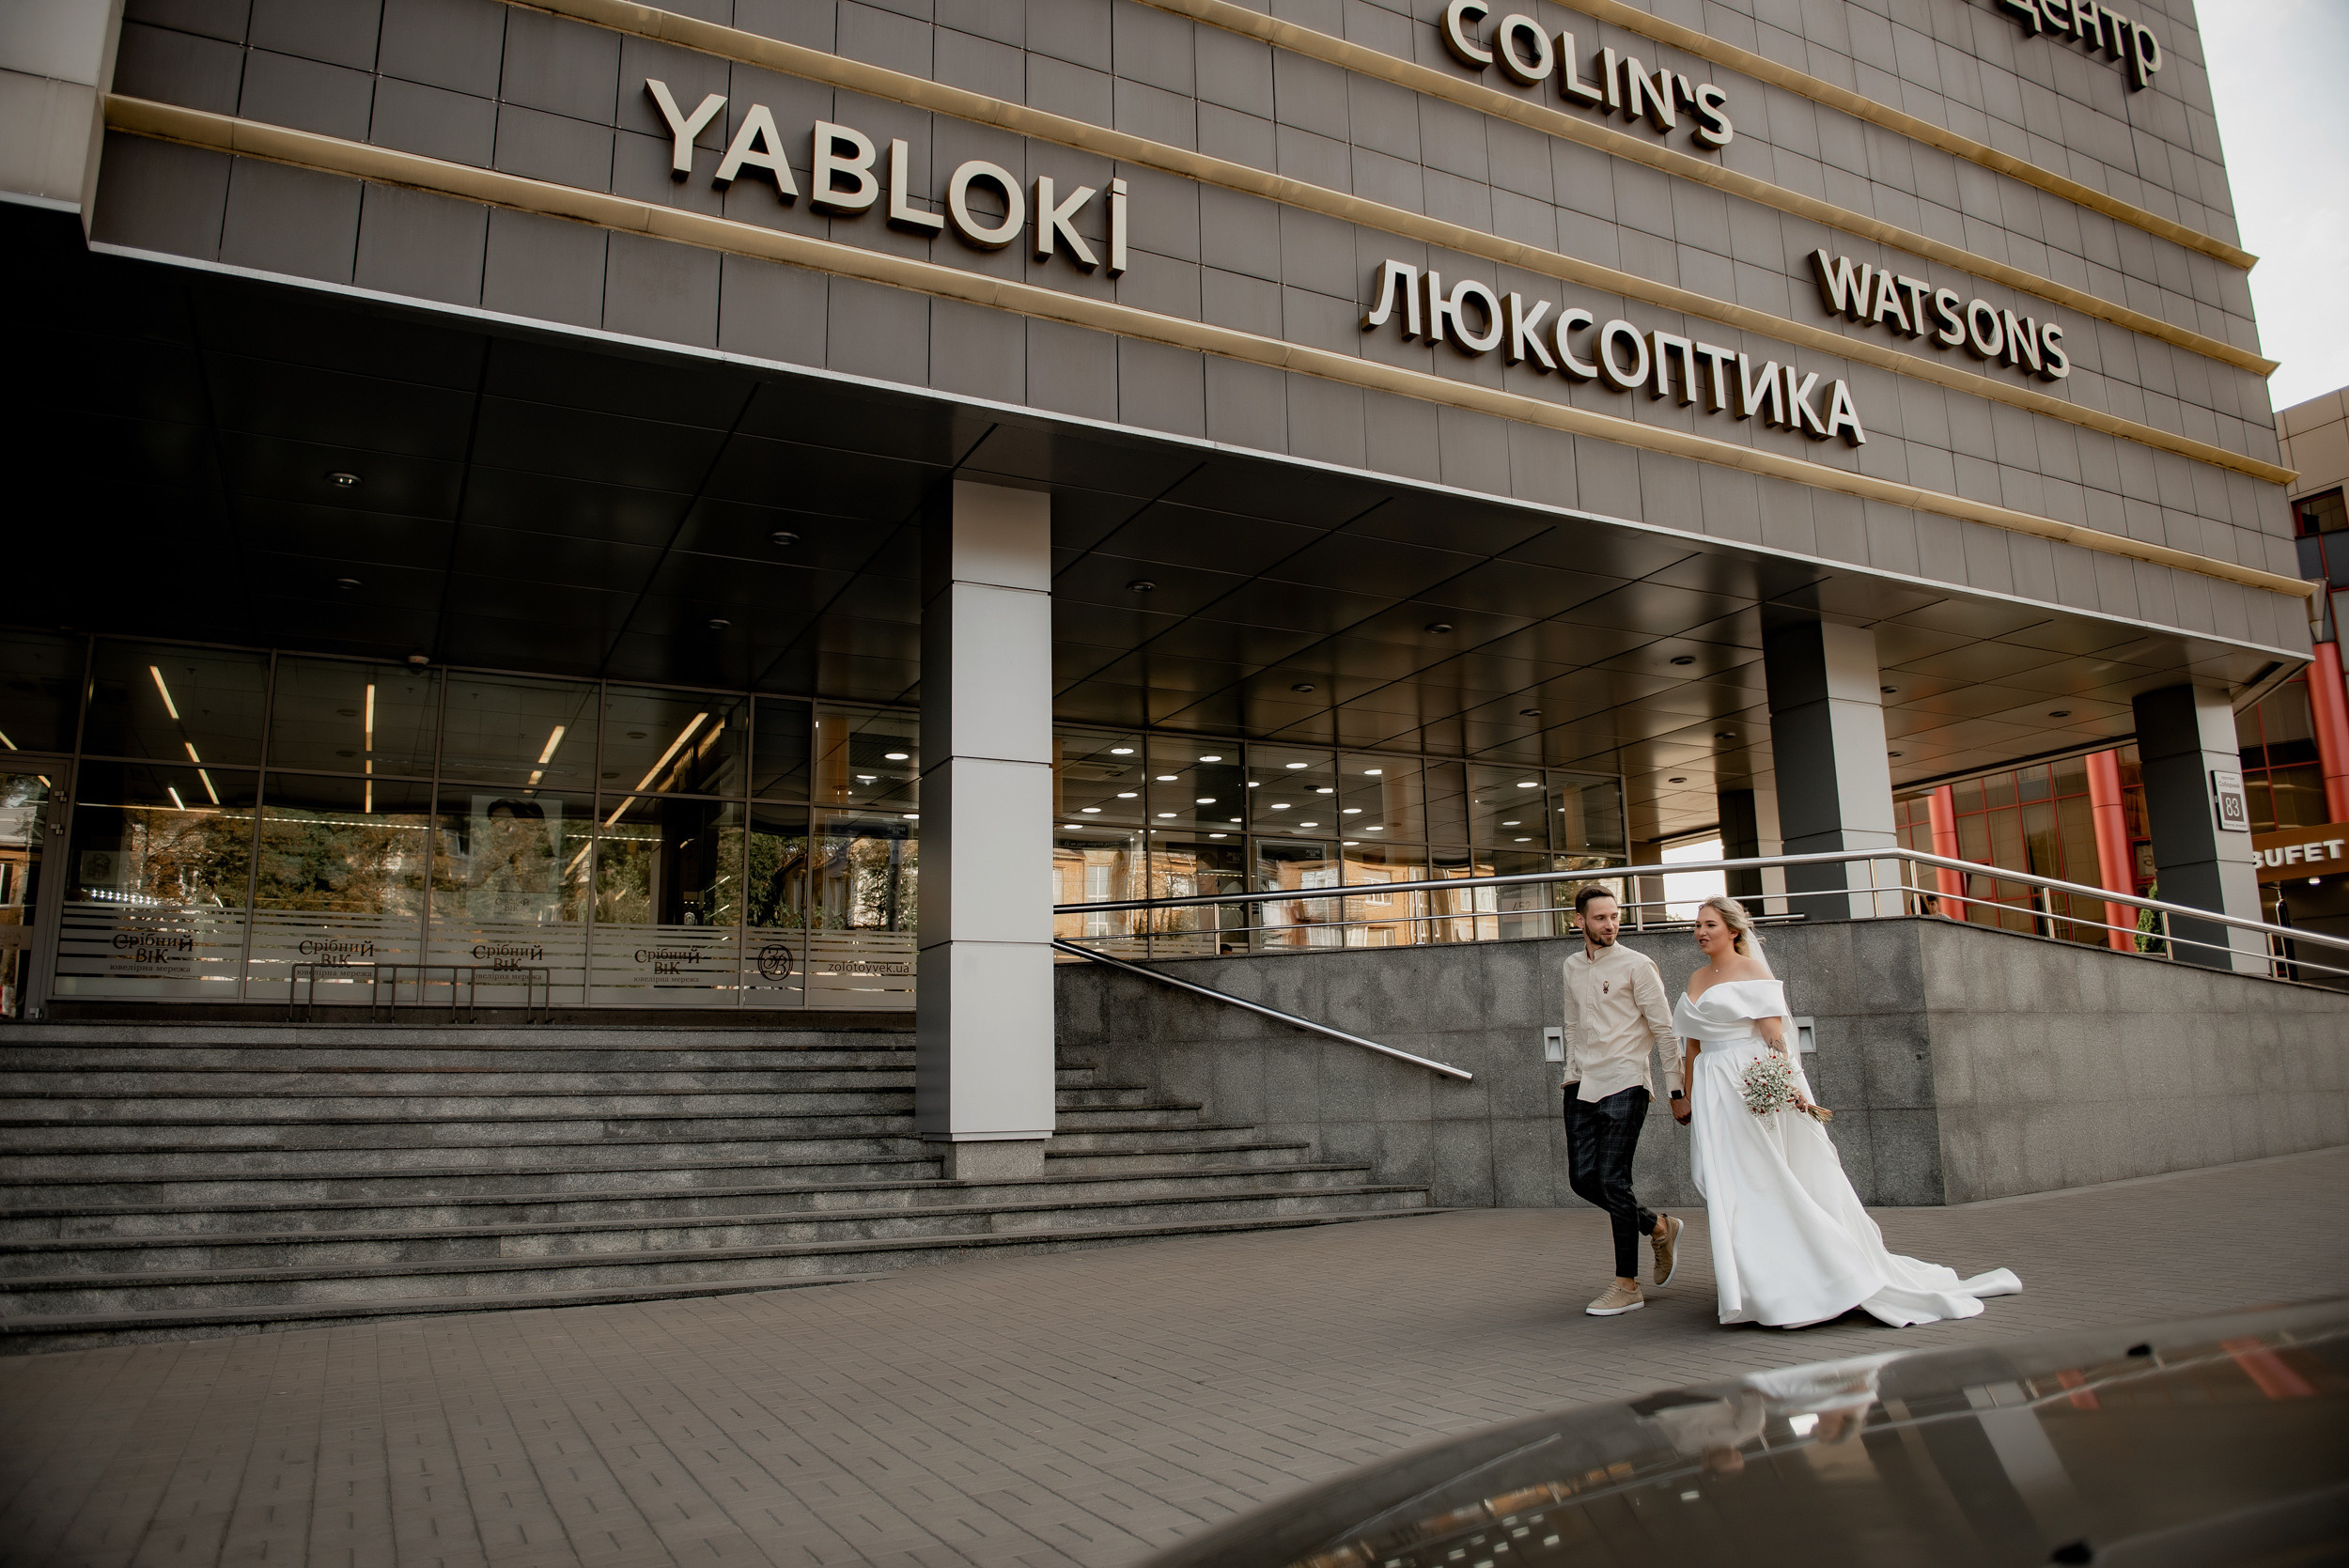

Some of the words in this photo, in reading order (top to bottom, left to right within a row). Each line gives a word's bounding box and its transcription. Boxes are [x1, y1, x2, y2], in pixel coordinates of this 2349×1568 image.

[1441, 0, 1734, 148] COLIN'S
[1361, 258, 1867, 448] ЛЮКСОПТИКА
[1809, 248, 2070, 380] WATSONS
[2225, 797, 2240, 817] 83
[828, 962, 910, 975] zolotoyvek.ua
